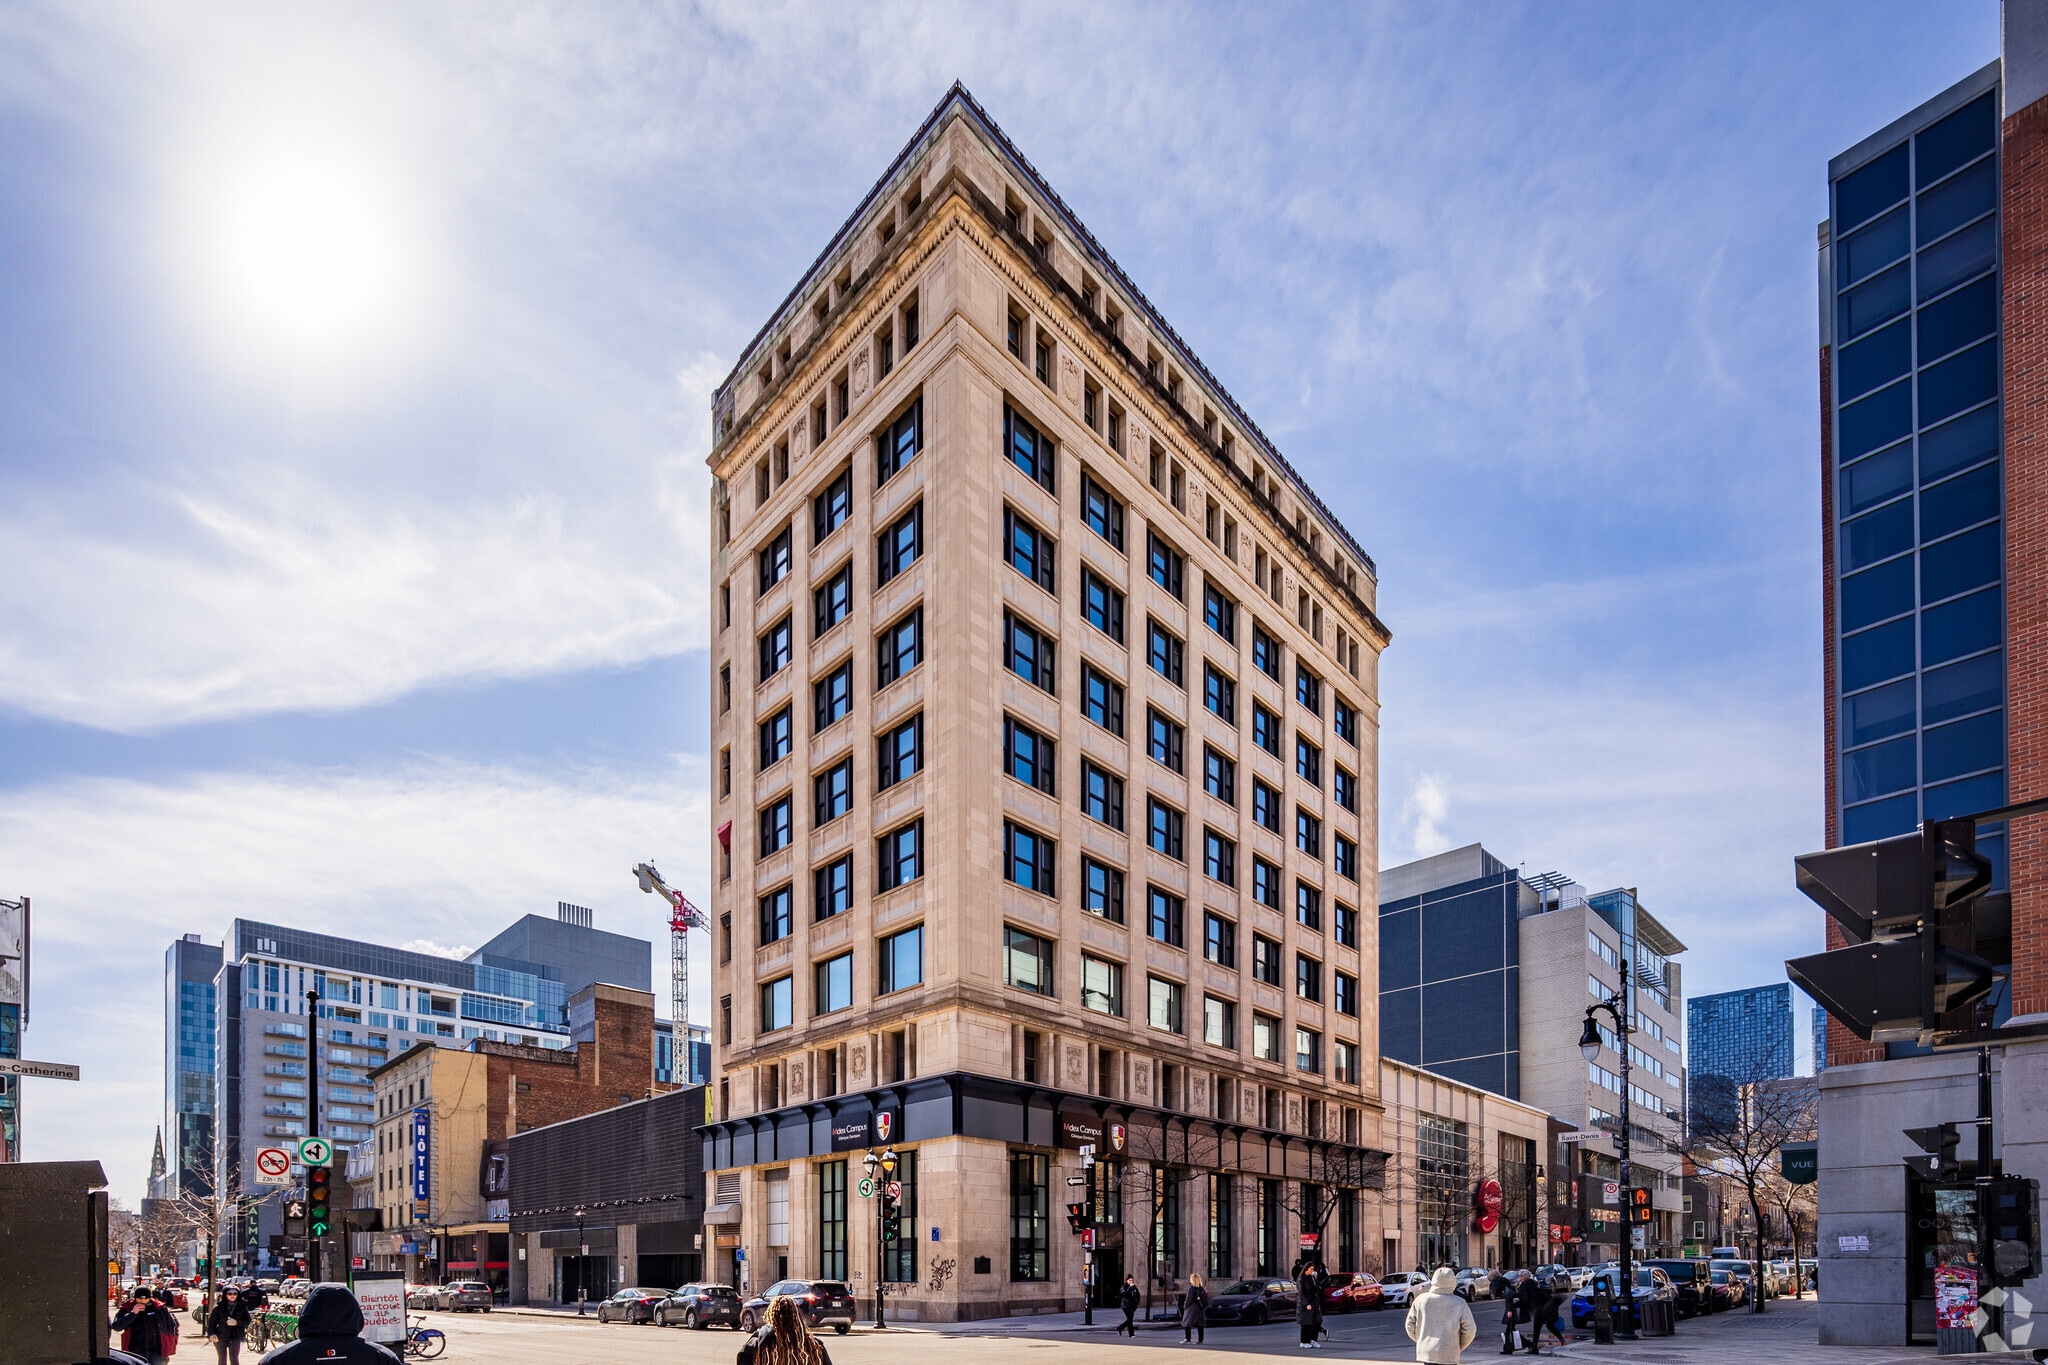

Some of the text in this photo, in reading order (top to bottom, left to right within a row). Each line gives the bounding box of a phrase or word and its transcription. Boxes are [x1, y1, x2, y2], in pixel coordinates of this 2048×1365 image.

[846, 1124, 867, 1134] Campus
[1063, 1123, 1102, 1136] Mdex Campus
[1561, 1133, 1599, 1141] Saint-Denis
[417, 1124, 426, 1195] HÔTEL
[361, 1294, 399, 1302] Bientôt
